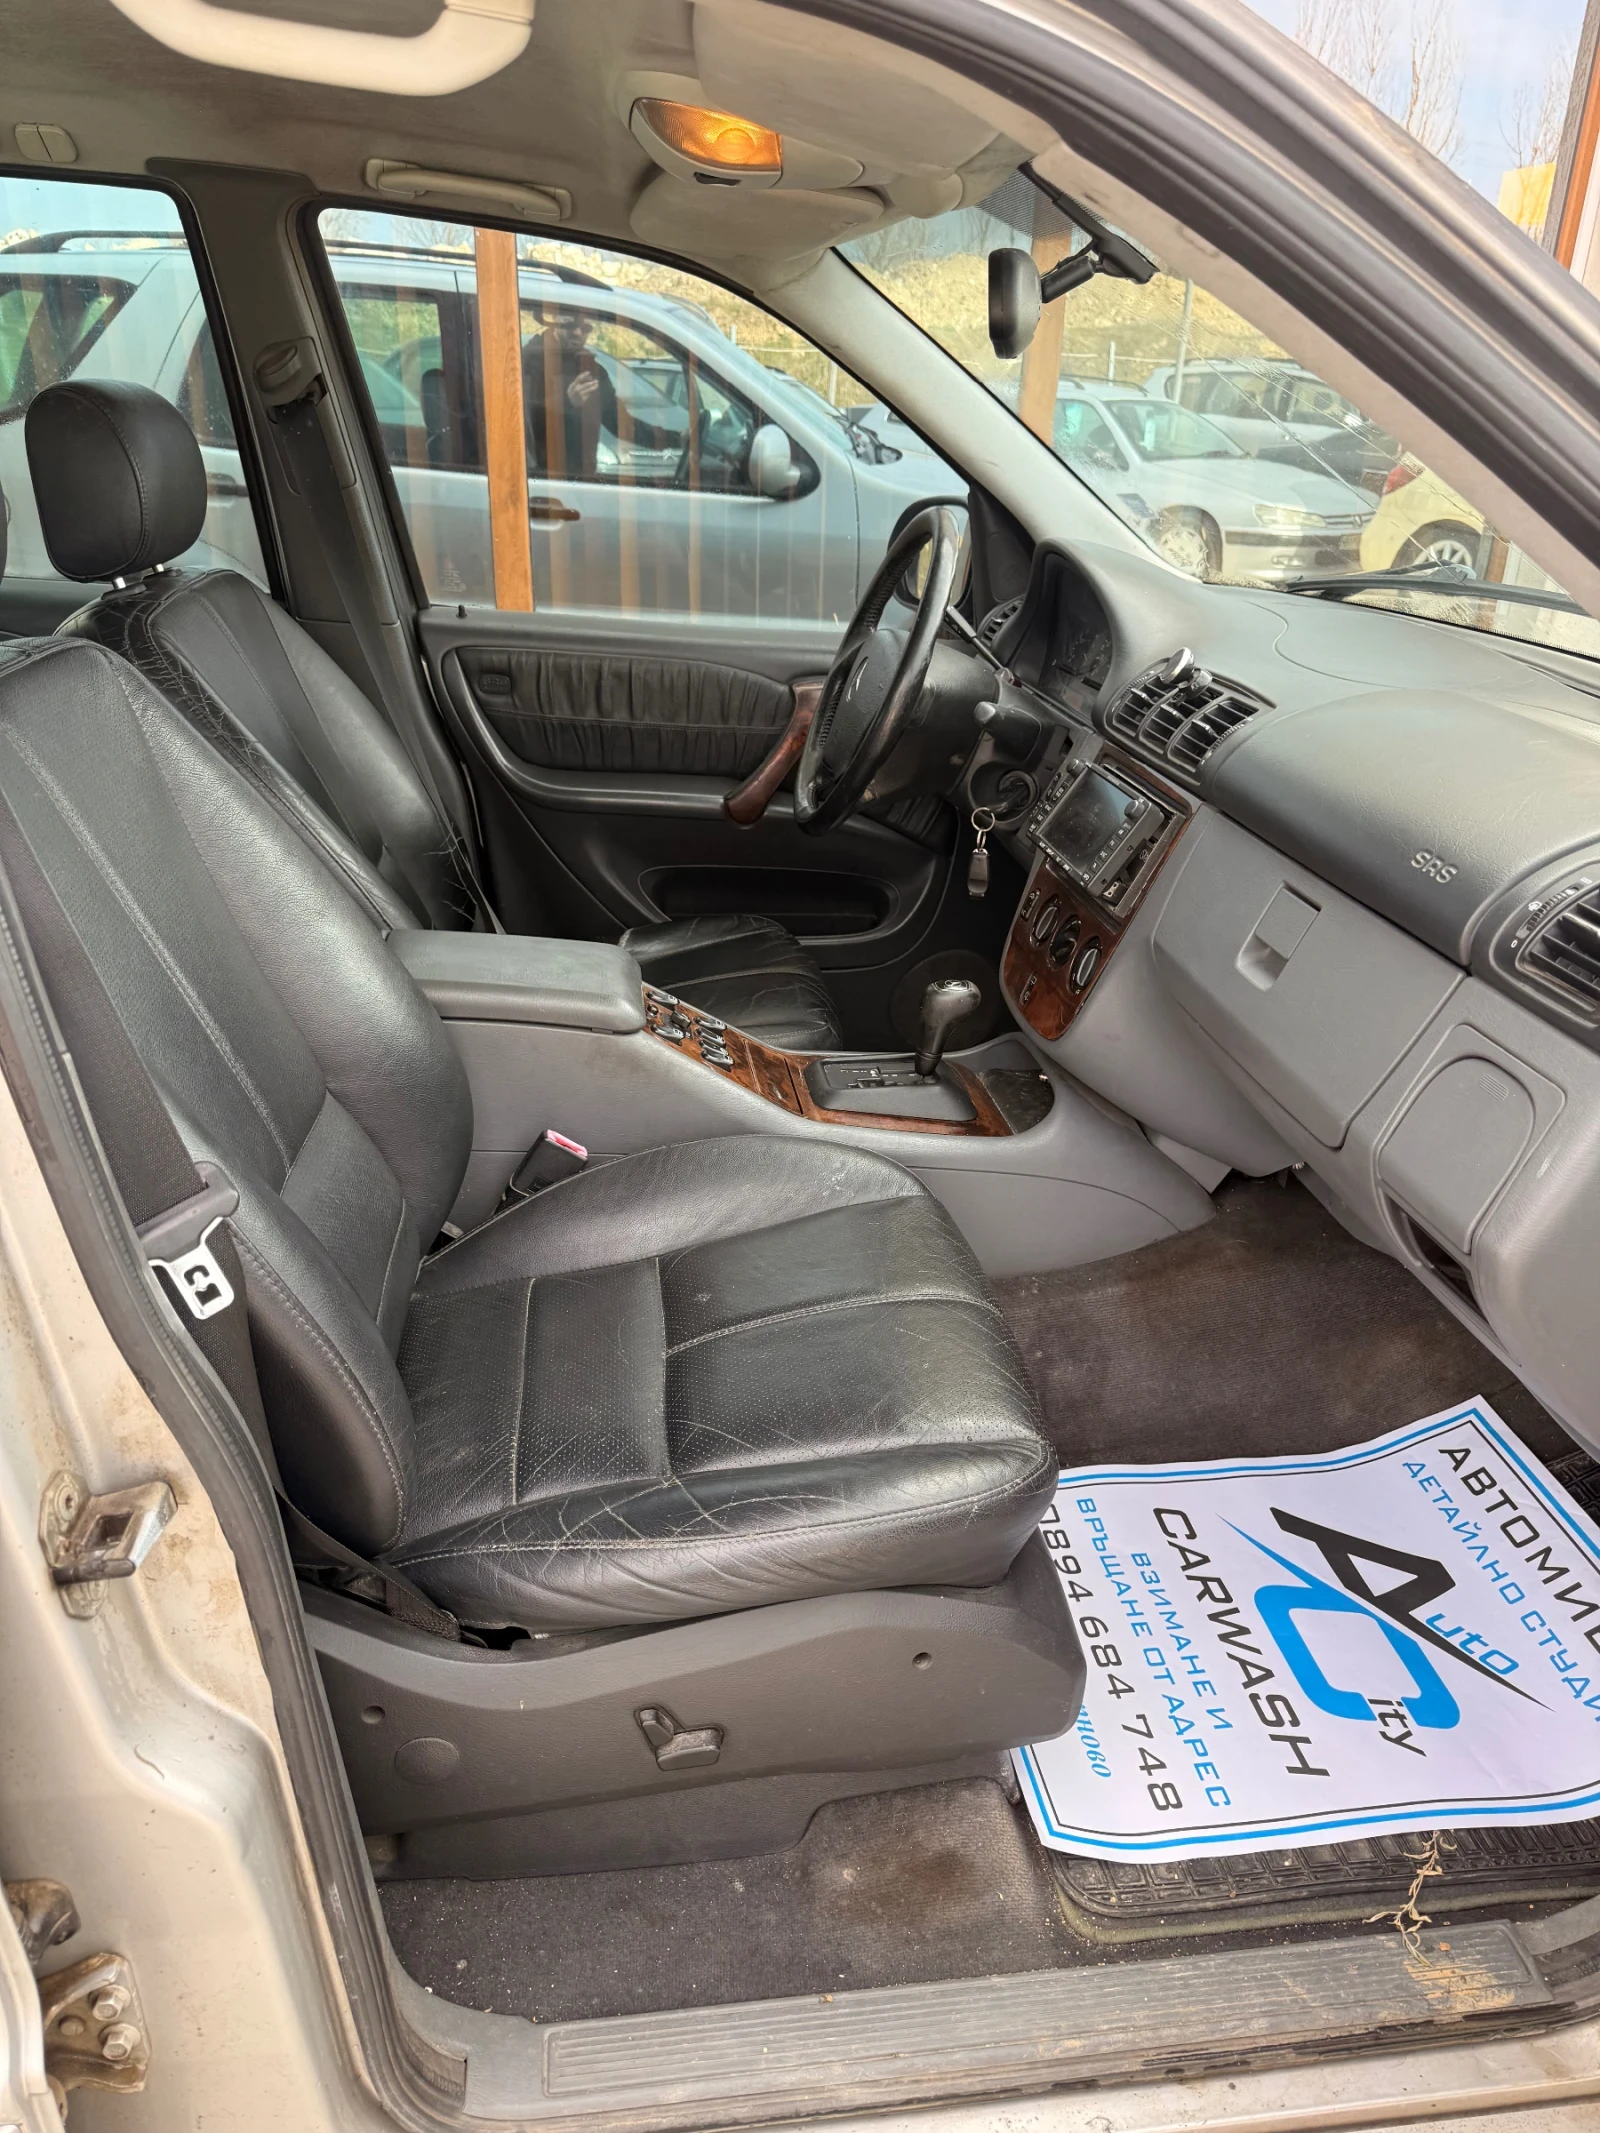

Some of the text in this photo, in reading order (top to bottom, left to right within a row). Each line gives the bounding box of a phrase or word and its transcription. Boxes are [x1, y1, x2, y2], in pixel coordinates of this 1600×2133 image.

[1411, 850, 1458, 884] SRS
[1402, 1462, 1526, 1605] ДЕТАЙЛНО
[1076, 1498, 1231, 1807] ВРЪЩАНЕ ОТ АДРЕС
[1079, 1616, 1136, 1699] 684
[1121, 1713, 1183, 1811] 748
[1131, 1552, 1233, 1730] ВЗИМАНЕ И
[1153, 1507, 1330, 1777] CARWASH
